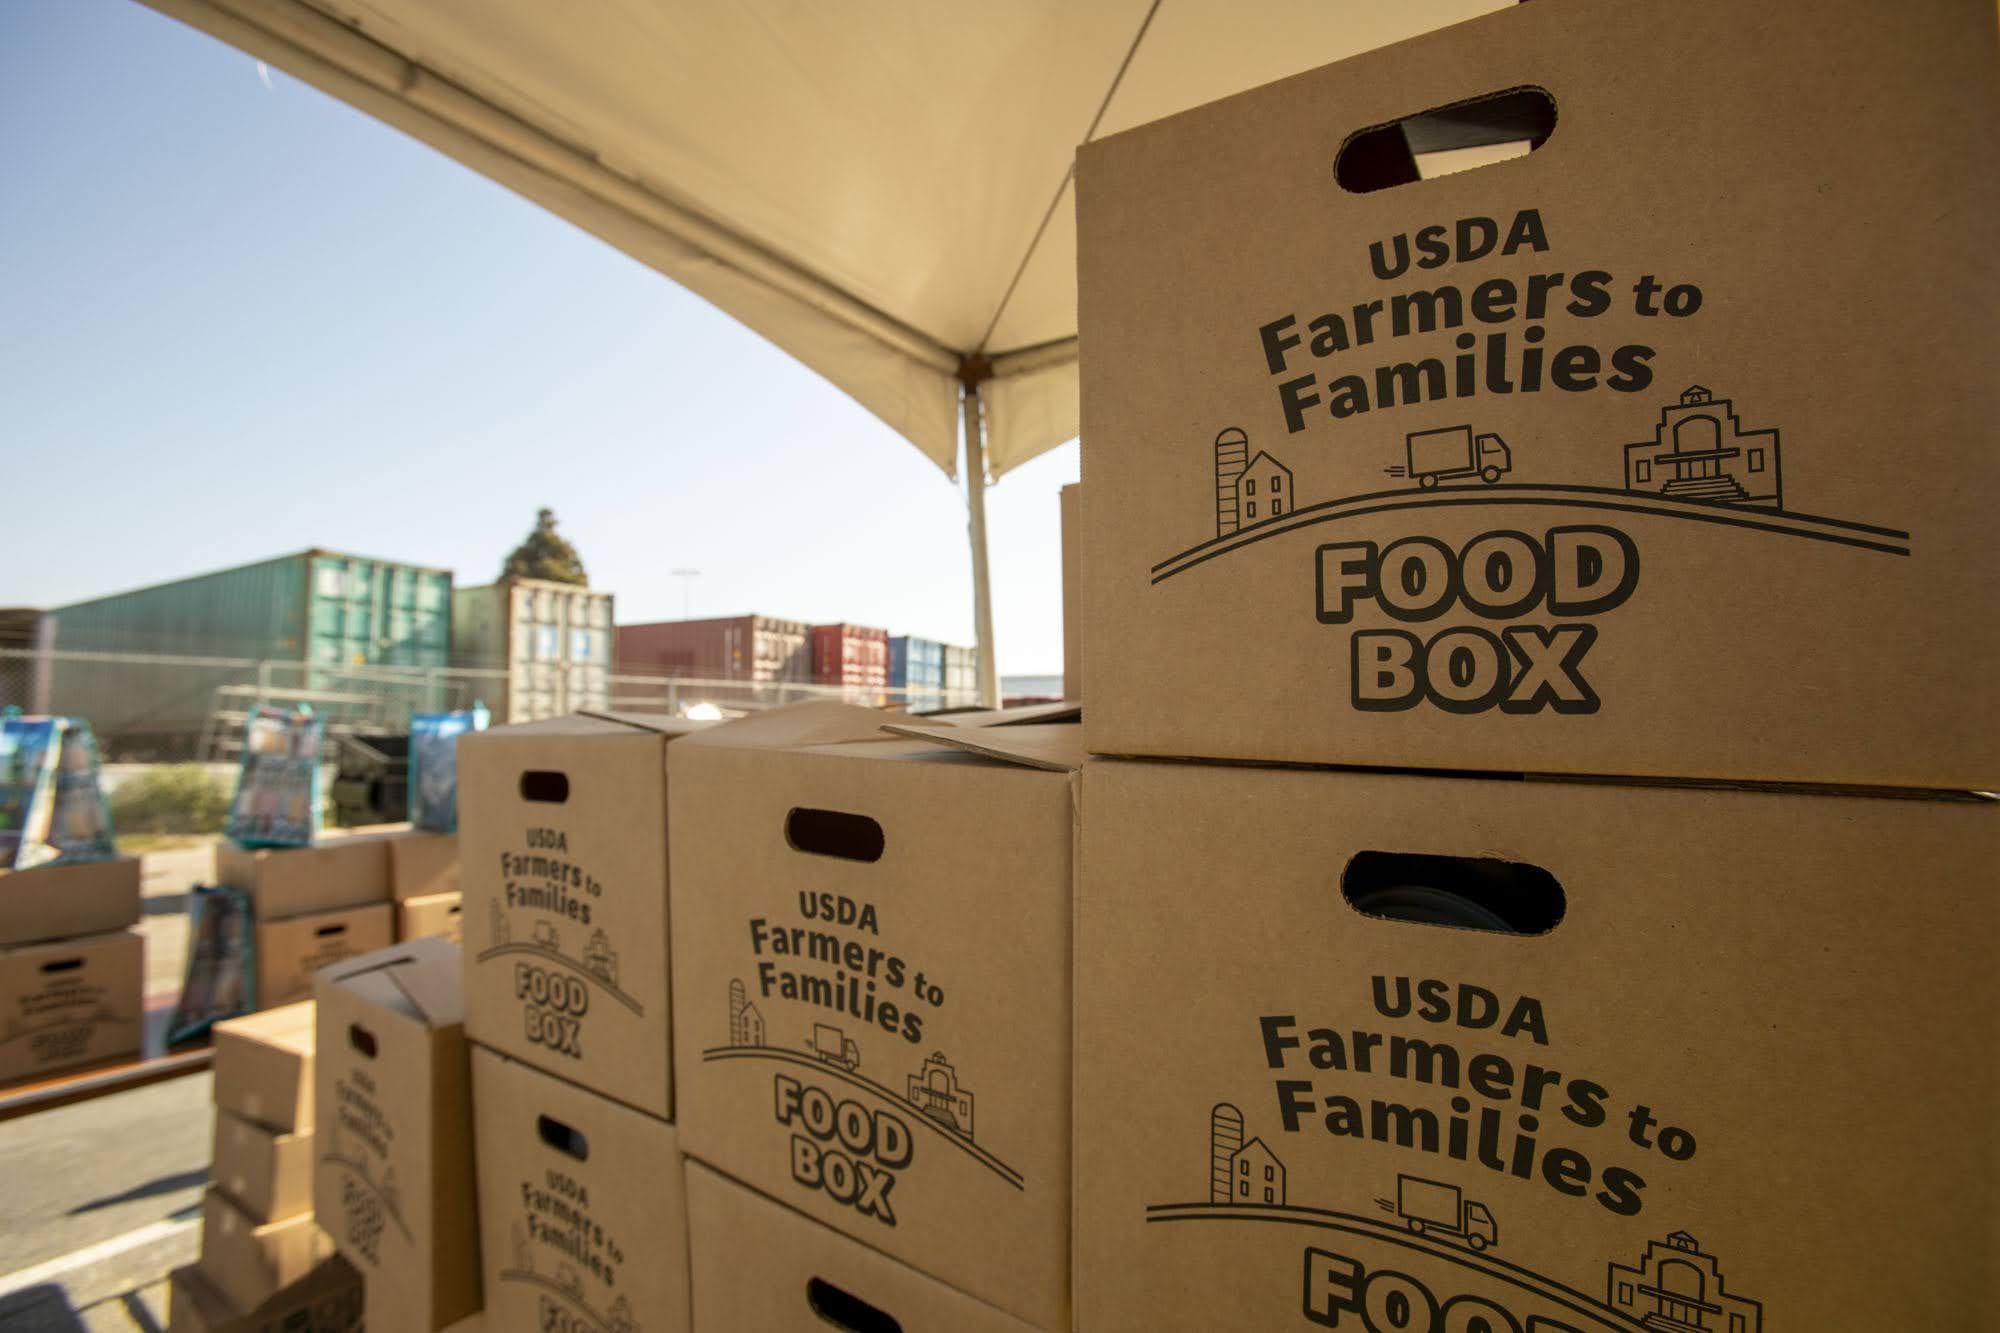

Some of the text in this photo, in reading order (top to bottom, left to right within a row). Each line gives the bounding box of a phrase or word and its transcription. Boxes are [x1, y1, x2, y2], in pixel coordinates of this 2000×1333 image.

[1369, 209, 1549, 280] USDA
[1258, 268, 1702, 375] Farmers to
[1278, 328, 1656, 434] Families
[1316, 524, 1638, 623] FOOD
[1350, 624, 1600, 715] BOX
[501, 852, 602, 897] Farmers to
[526, 828, 568, 852] USDA
[506, 882, 592, 924] Families
[799, 890, 878, 935] USDA
[515, 961, 588, 1017] FOOD
[749, 918, 944, 1007] Farmers to
[758, 961, 923, 1044] Families
[525, 1004, 582, 1059] BOX
[1371, 974, 1549, 1045] USDA
[774, 1072, 914, 1169] FOOD
[1259, 1015, 1697, 1160] Farmers to
[790, 1136, 897, 1226] BOX
[1276, 1079, 1646, 1216] Families
[1303, 1246, 1589, 1333] FO
